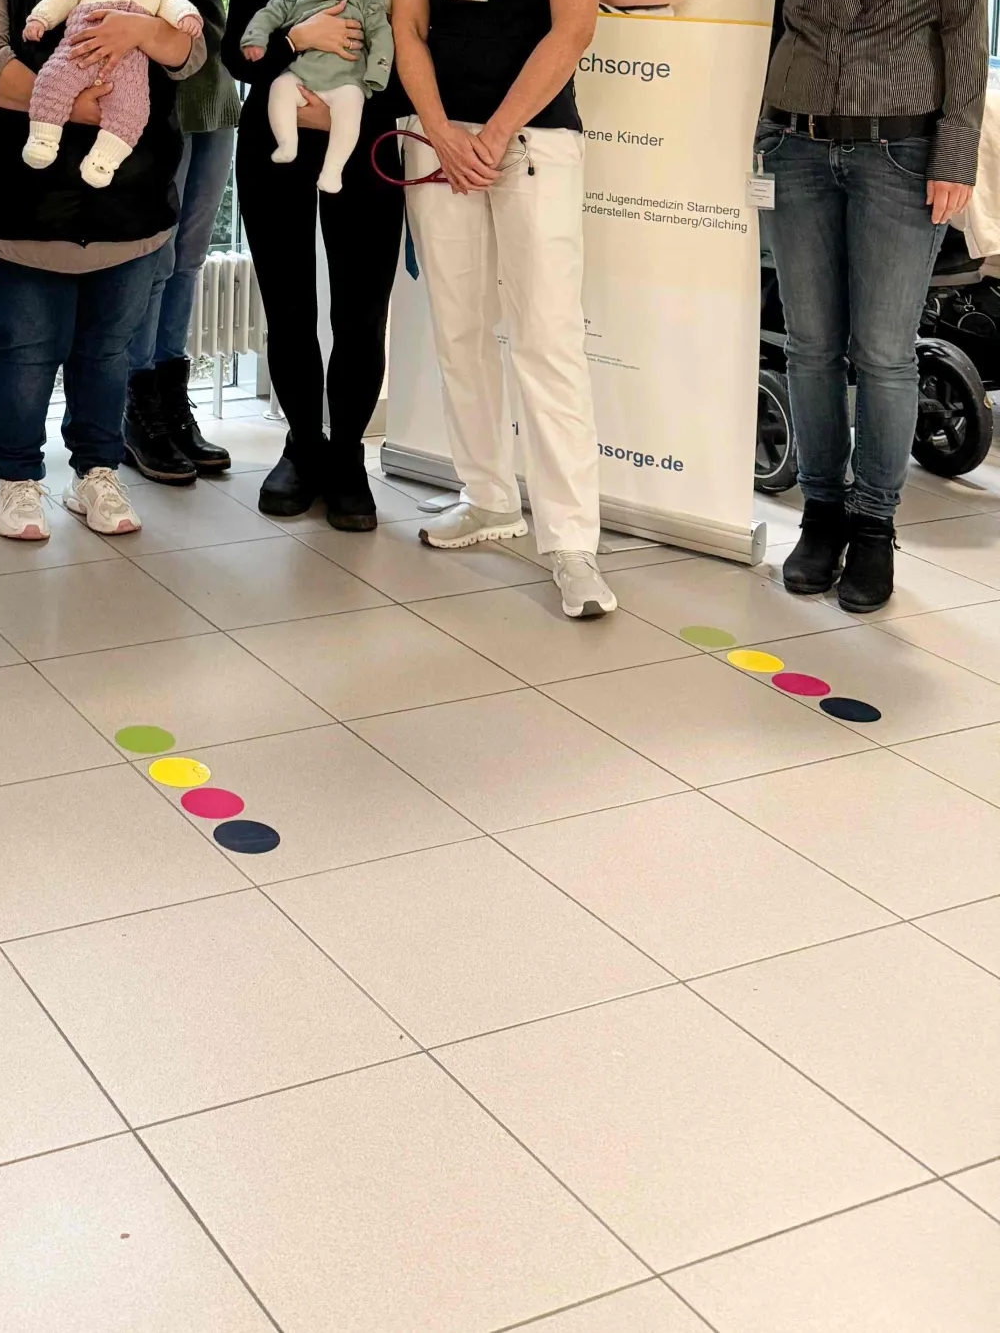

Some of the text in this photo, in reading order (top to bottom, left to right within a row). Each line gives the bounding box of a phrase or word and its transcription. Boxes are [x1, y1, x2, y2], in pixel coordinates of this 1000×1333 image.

[578, 53, 671, 82] chsorge
[583, 129, 664, 147] rene Kinder
[585, 192, 740, 218] und Jugendmedizin Starnberg
[643, 211, 748, 234] Starnberg/Gilching
